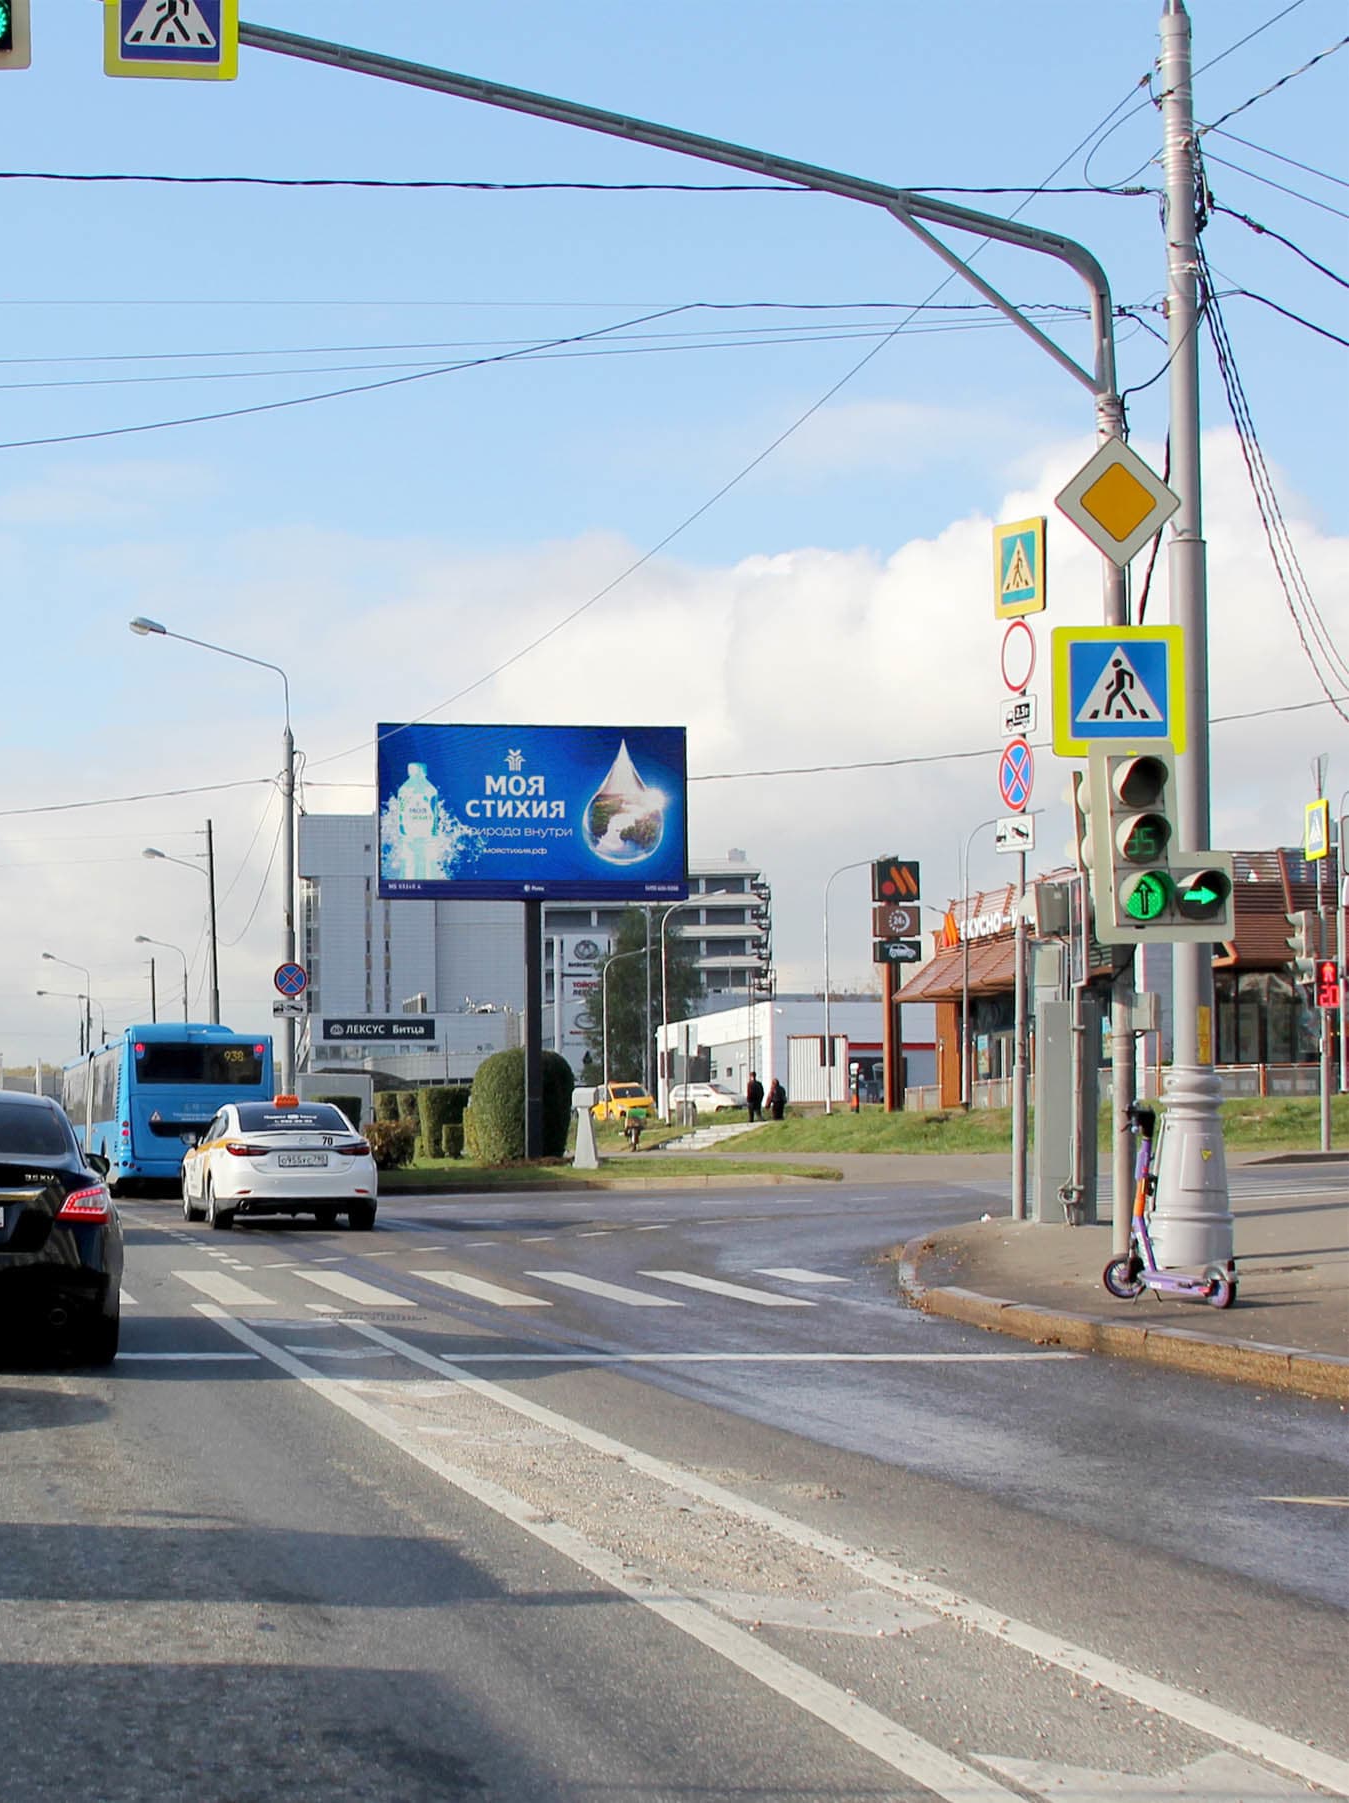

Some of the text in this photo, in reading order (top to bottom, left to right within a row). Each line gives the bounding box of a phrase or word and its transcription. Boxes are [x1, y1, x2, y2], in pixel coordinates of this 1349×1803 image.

[485, 775, 545, 796] МОЯ
[465, 800, 566, 819] СТИХИЯ
[524, 827, 573, 838] внутри
[1319, 985, 1340, 1007] 20
[346, 1024, 425, 1035] ЛЕКСУС Битца
[224, 1050, 244, 1061] 938
[322, 1136, 333, 1145] 70
